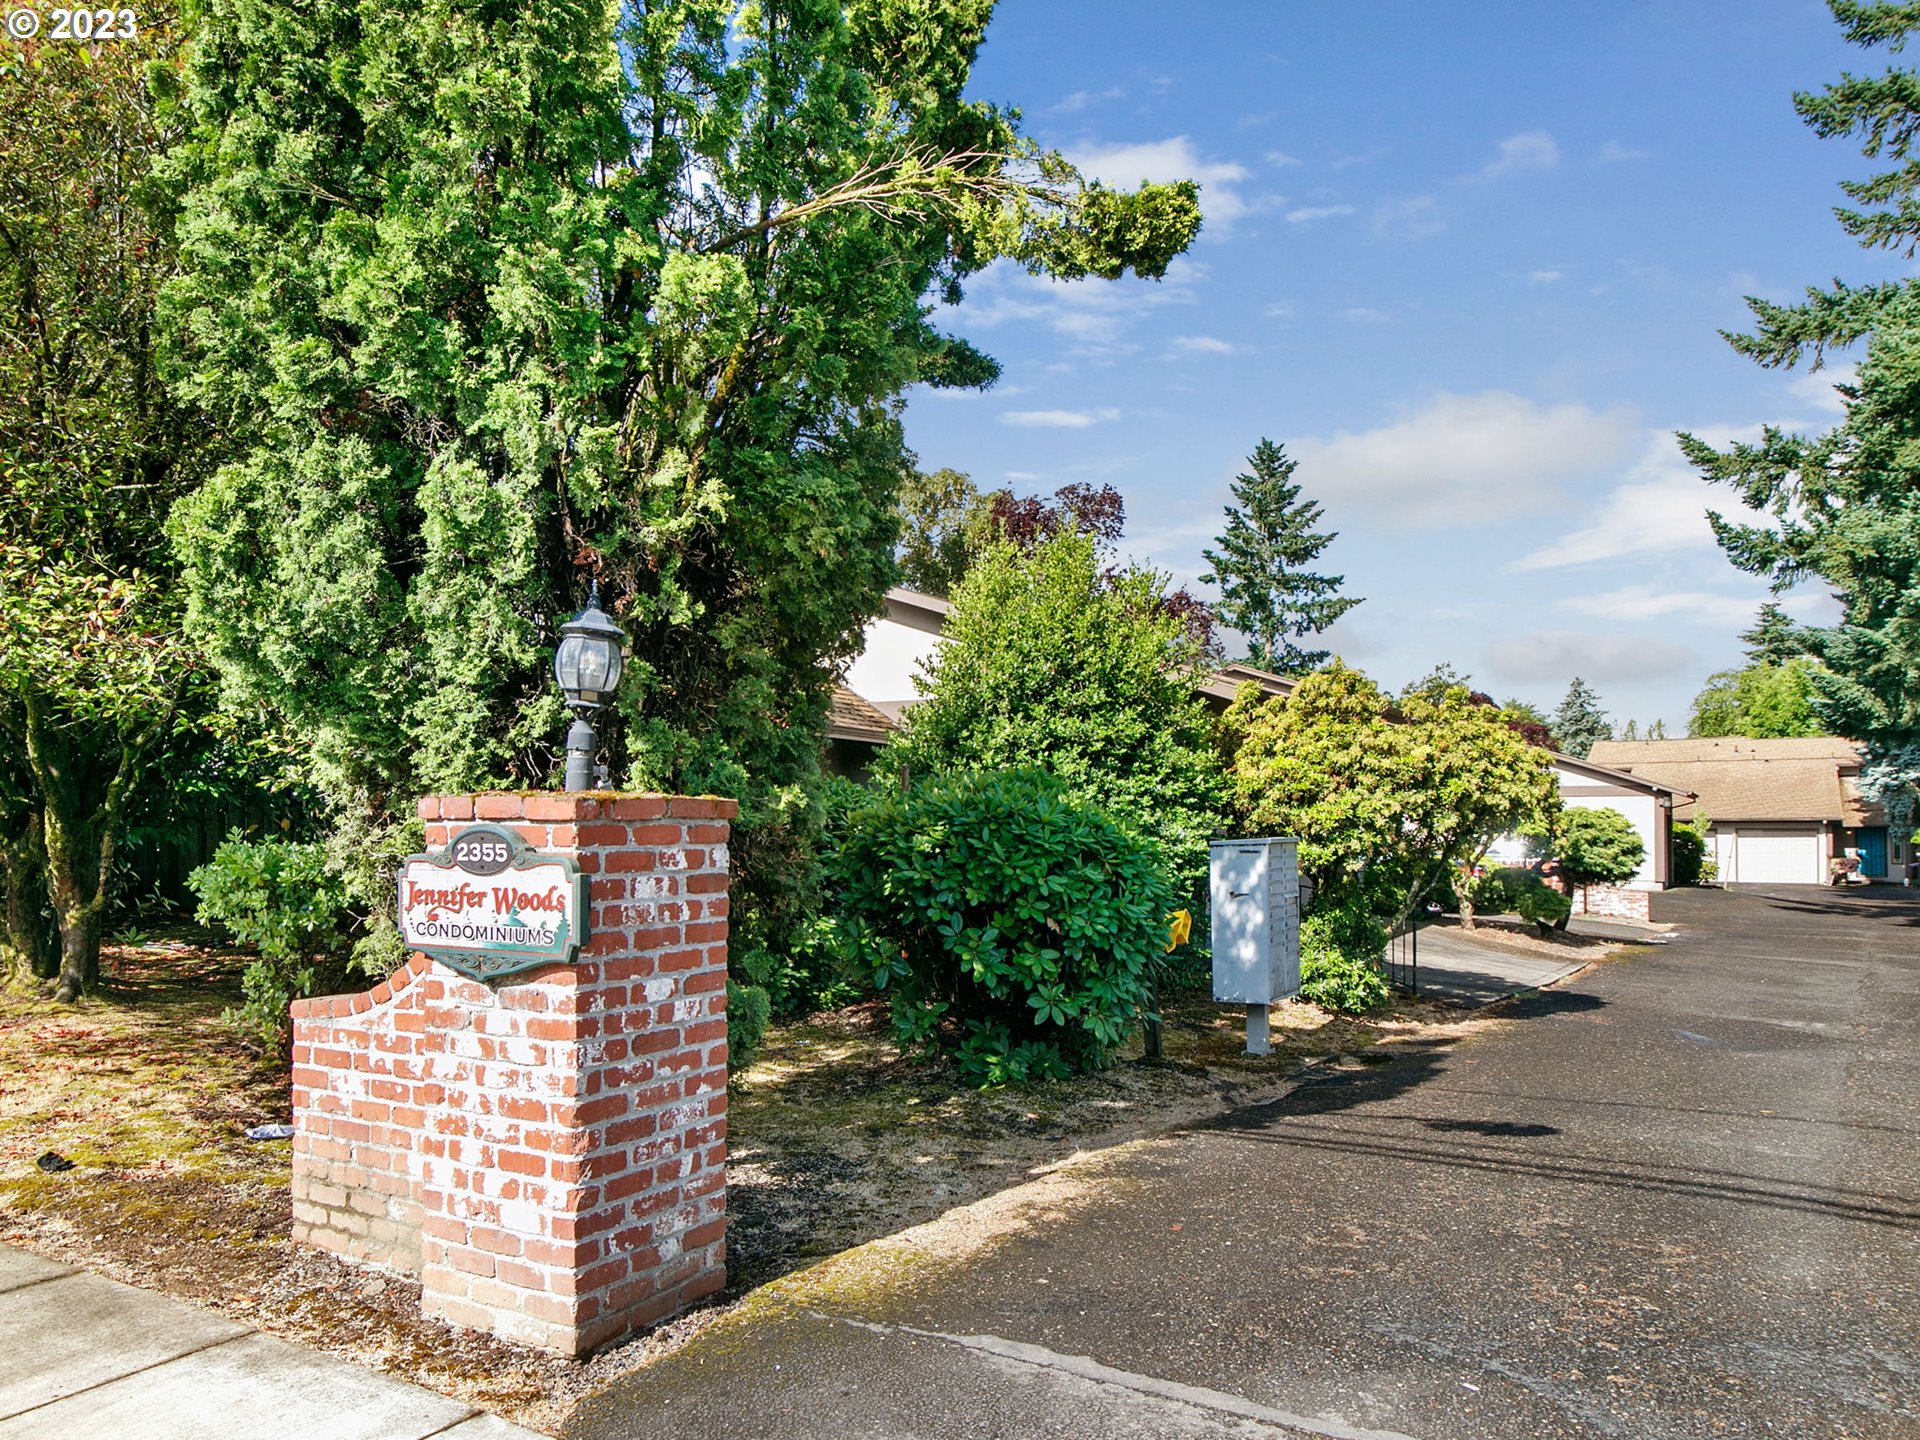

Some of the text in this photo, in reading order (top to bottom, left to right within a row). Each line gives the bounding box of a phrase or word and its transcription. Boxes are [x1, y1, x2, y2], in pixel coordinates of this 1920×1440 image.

[456, 843, 508, 863] 2355
[404, 880, 566, 921] Jennifer Woods
[415, 922, 555, 946] CONDOMINIUMS
